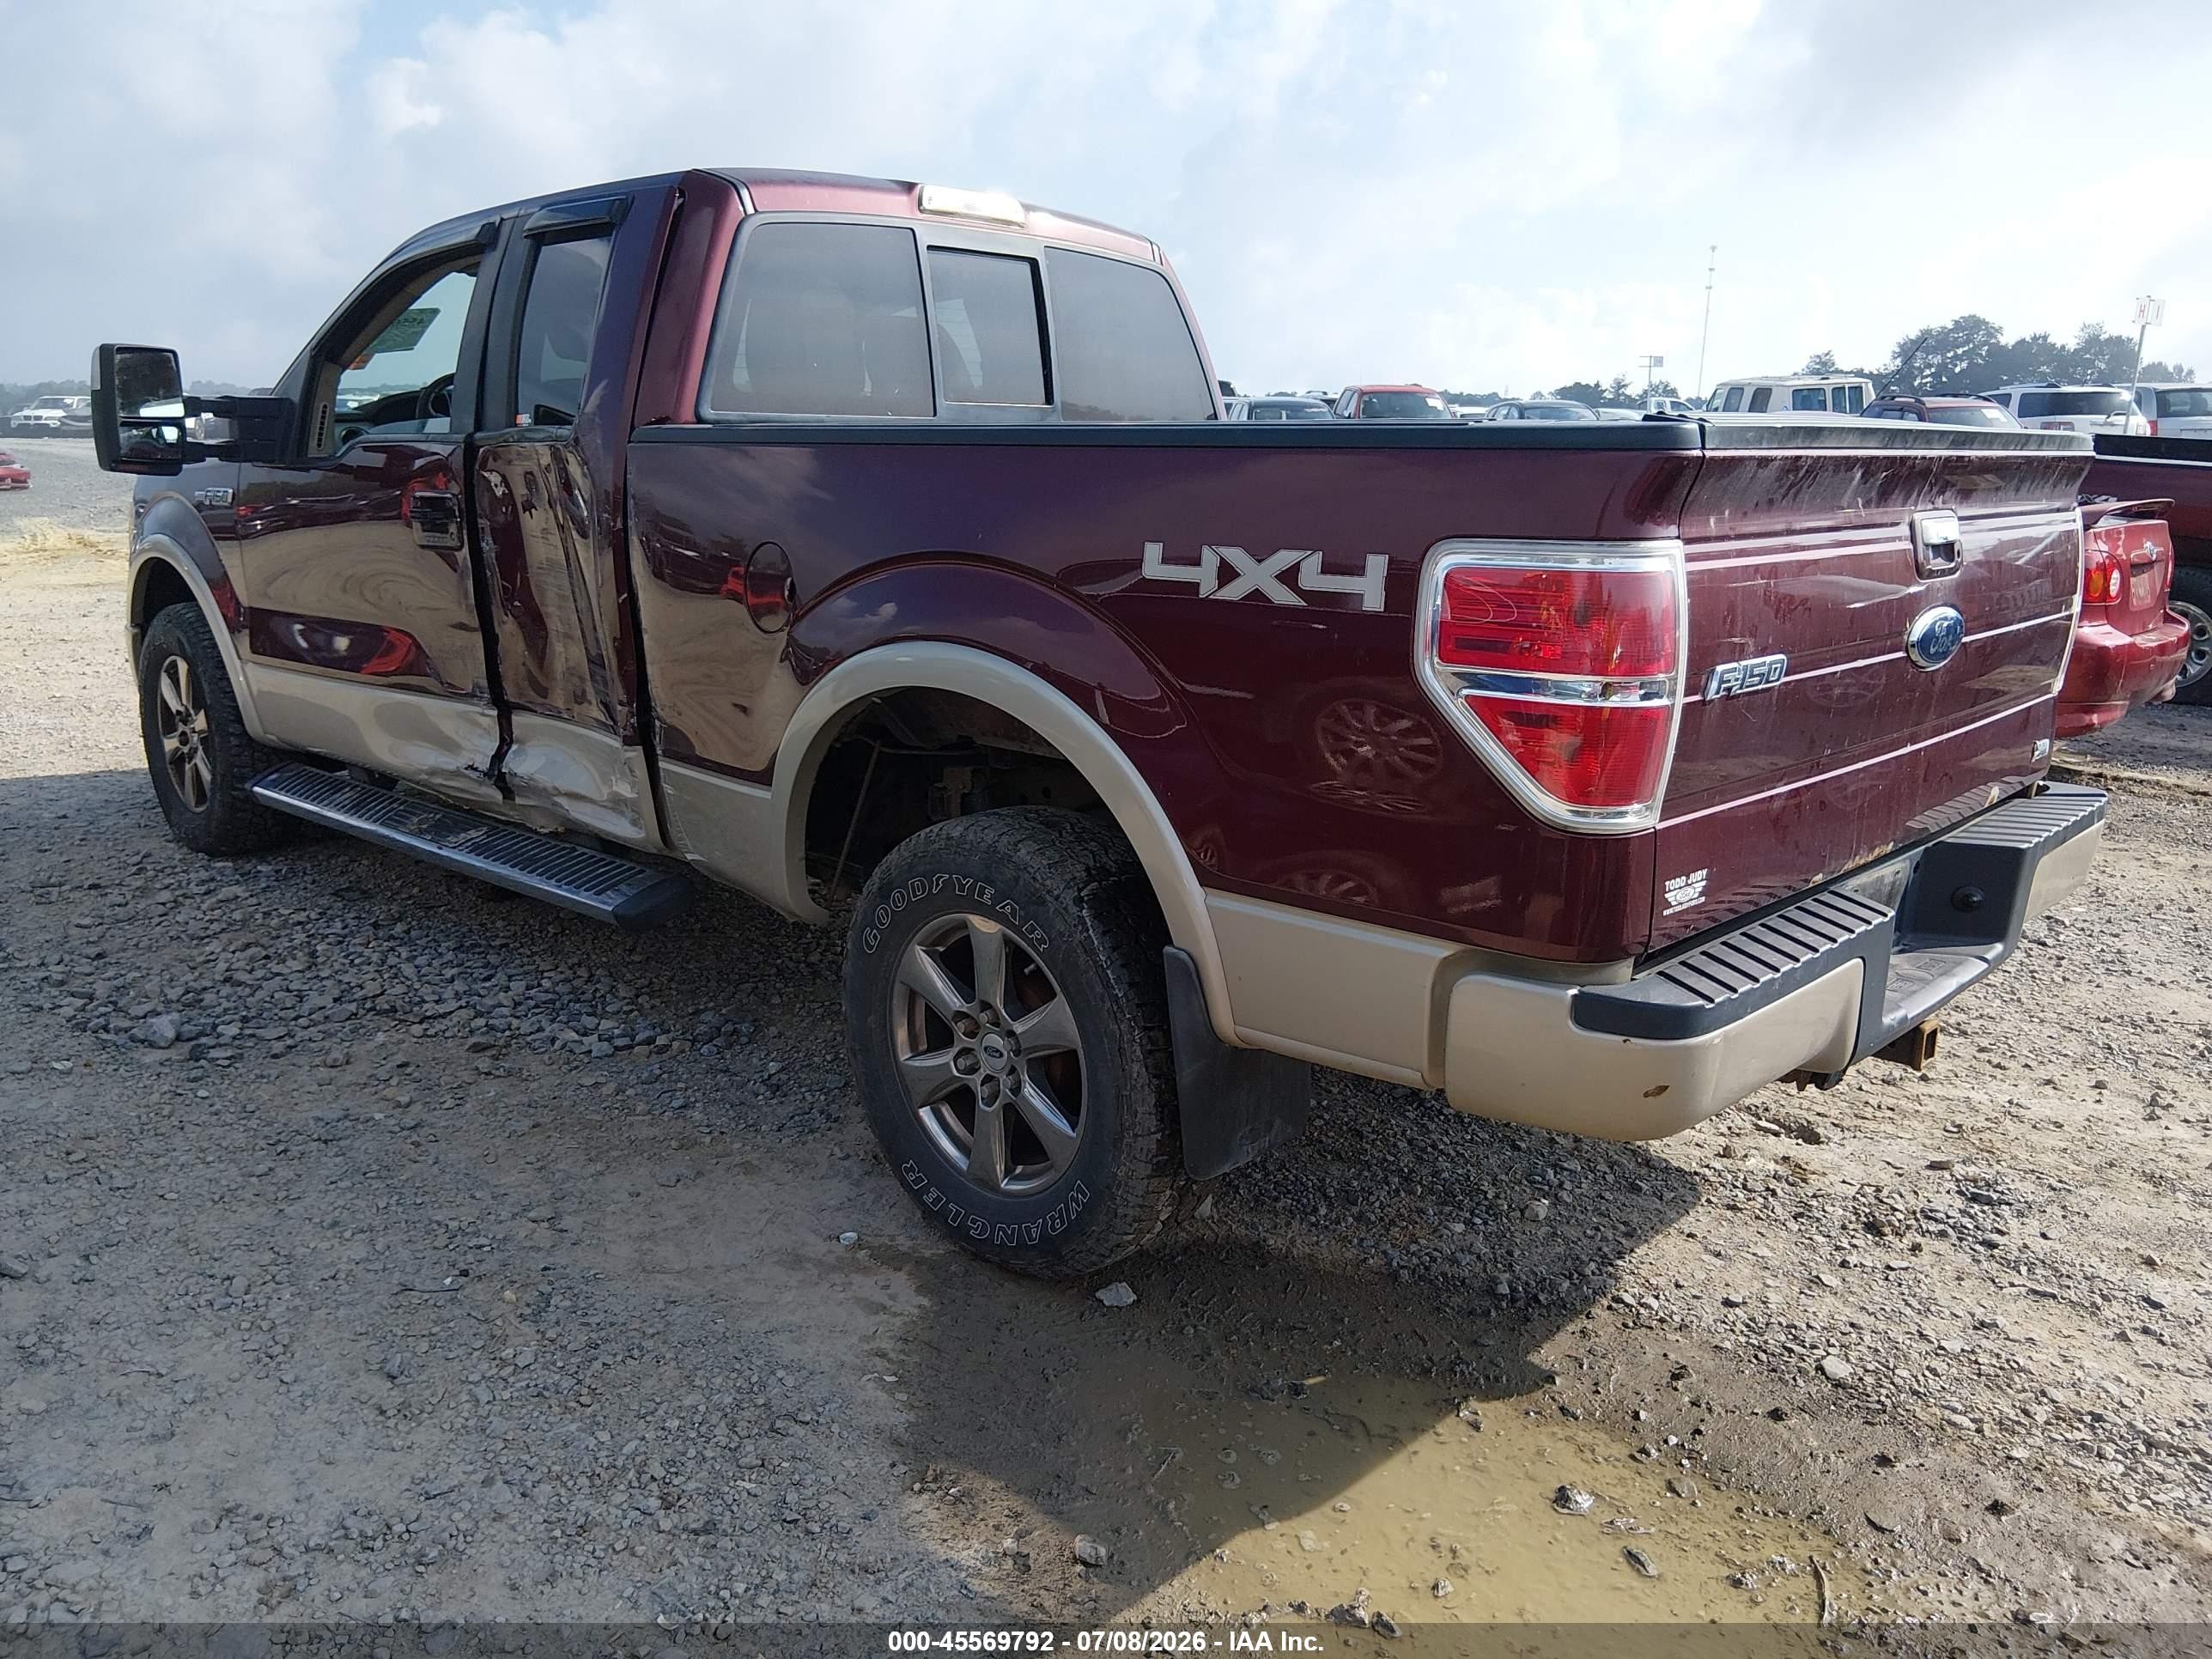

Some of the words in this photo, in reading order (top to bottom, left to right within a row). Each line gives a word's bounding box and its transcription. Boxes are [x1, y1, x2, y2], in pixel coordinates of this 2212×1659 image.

[1142, 542, 1389, 611] 4X4
[862, 873, 1049, 954] GOODYEAR
[1664, 876, 1686, 891] TODD
[1687, 868, 1708, 884] JUDY
[902, 1159, 1091, 1246] WRANGLER
